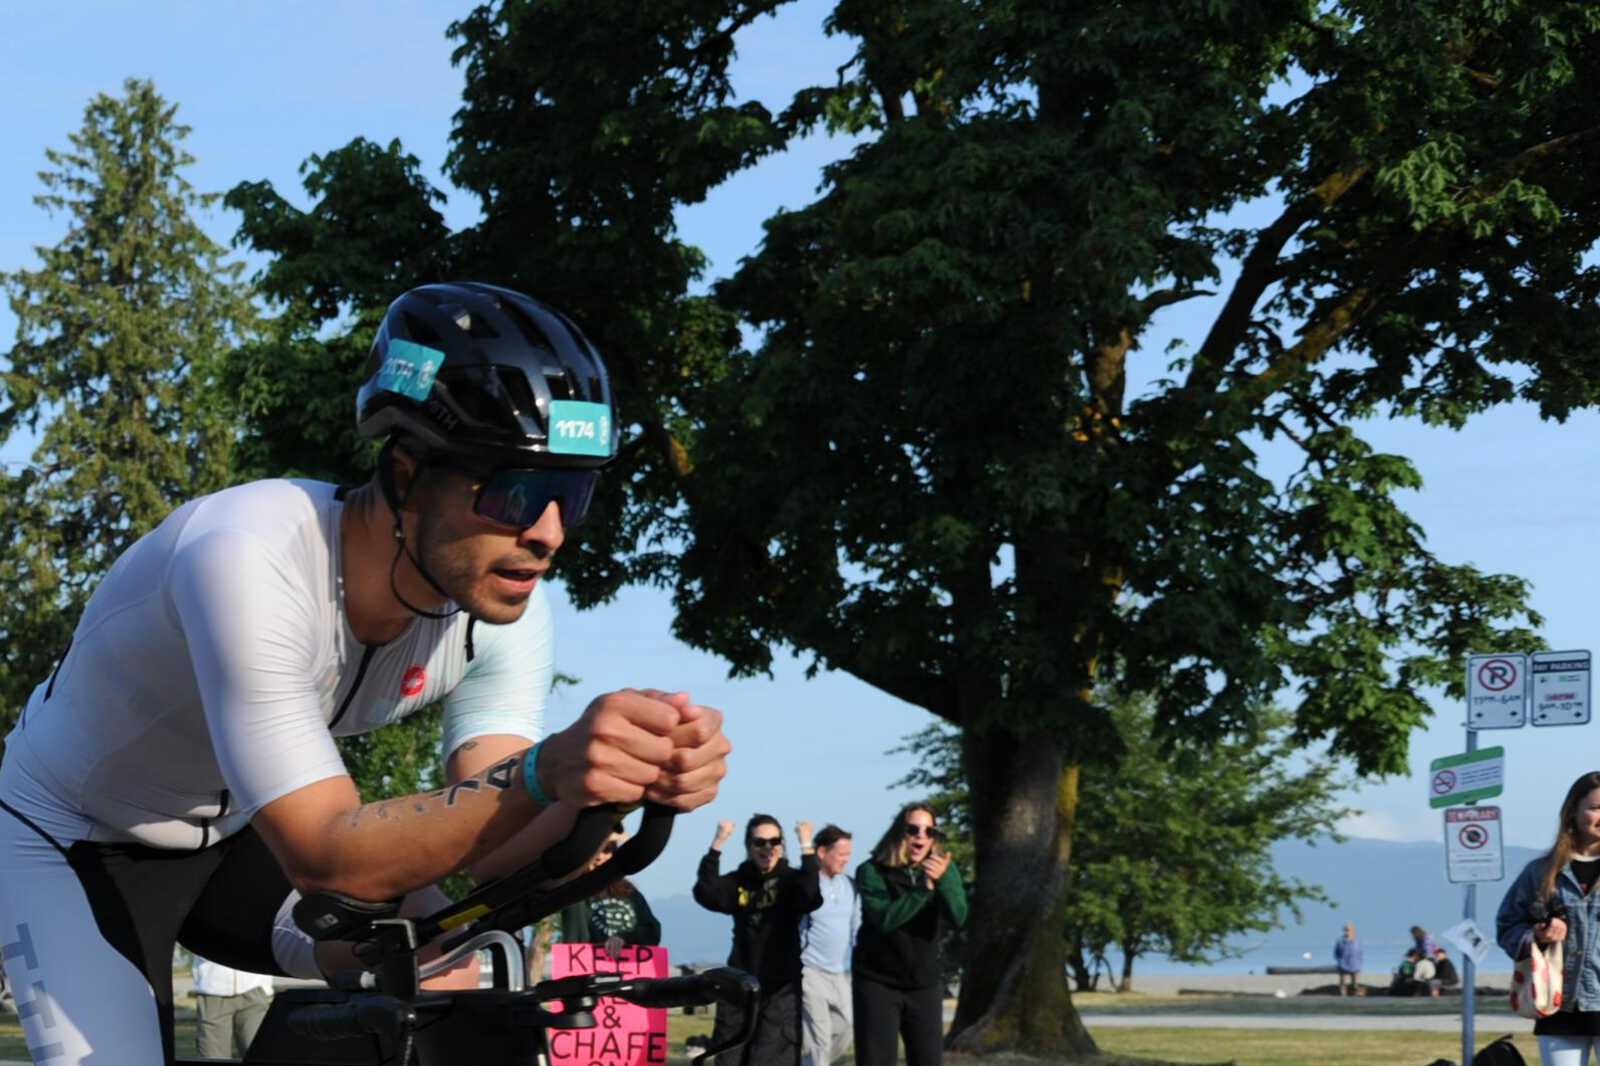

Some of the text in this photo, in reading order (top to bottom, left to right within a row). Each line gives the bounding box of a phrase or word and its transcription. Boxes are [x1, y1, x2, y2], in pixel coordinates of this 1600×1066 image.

[555, 420, 595, 439] 1174
[568, 945, 653, 975] KEEP
[602, 1005, 622, 1029] &
[551, 1031, 666, 1063] CHAFE
